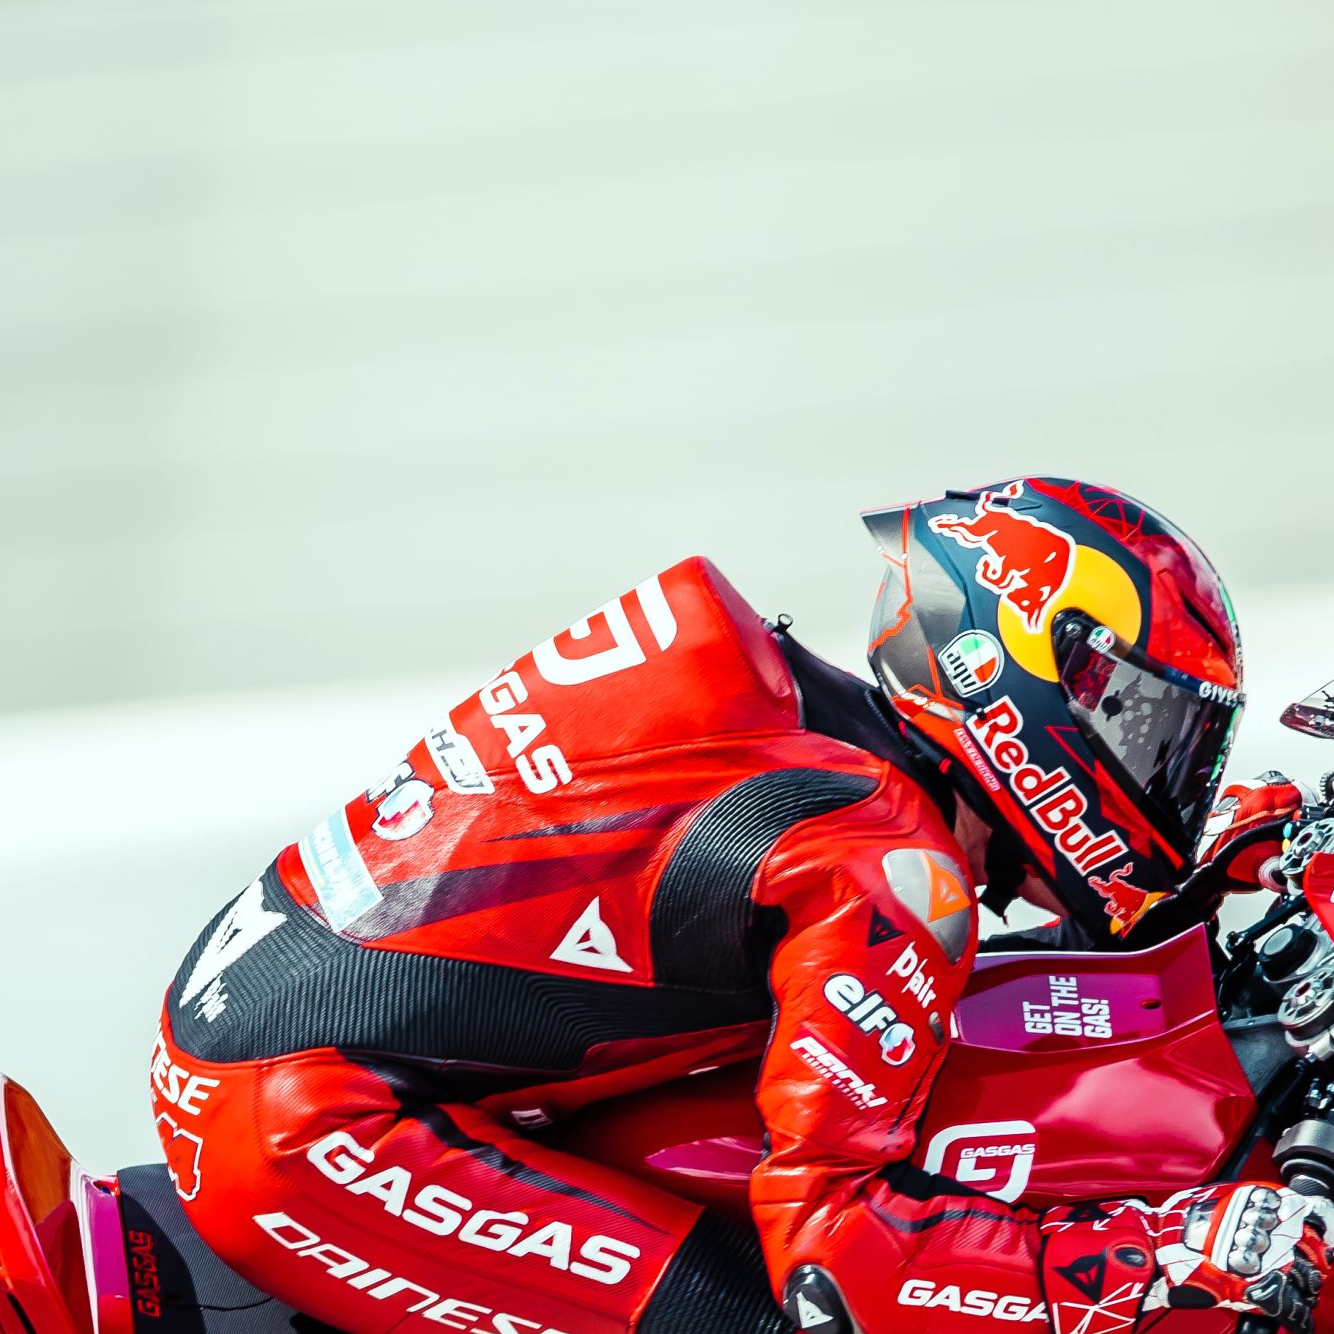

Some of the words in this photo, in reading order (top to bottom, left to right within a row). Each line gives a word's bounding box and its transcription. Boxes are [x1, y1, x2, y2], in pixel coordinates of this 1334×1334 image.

[478, 660, 574, 795] GAS
[823, 973, 898, 1034] elf
[1048, 975, 1079, 1006] THE
[1021, 1001, 1054, 1034] GET
[1053, 1011, 1084, 1037] ON
[1080, 997, 1113, 1039] GAS!
[959, 1143, 1036, 1160] GASGAS
[305, 1130, 641, 1286] GASGAS
[896, 1278, 1051, 1324] GASGA
